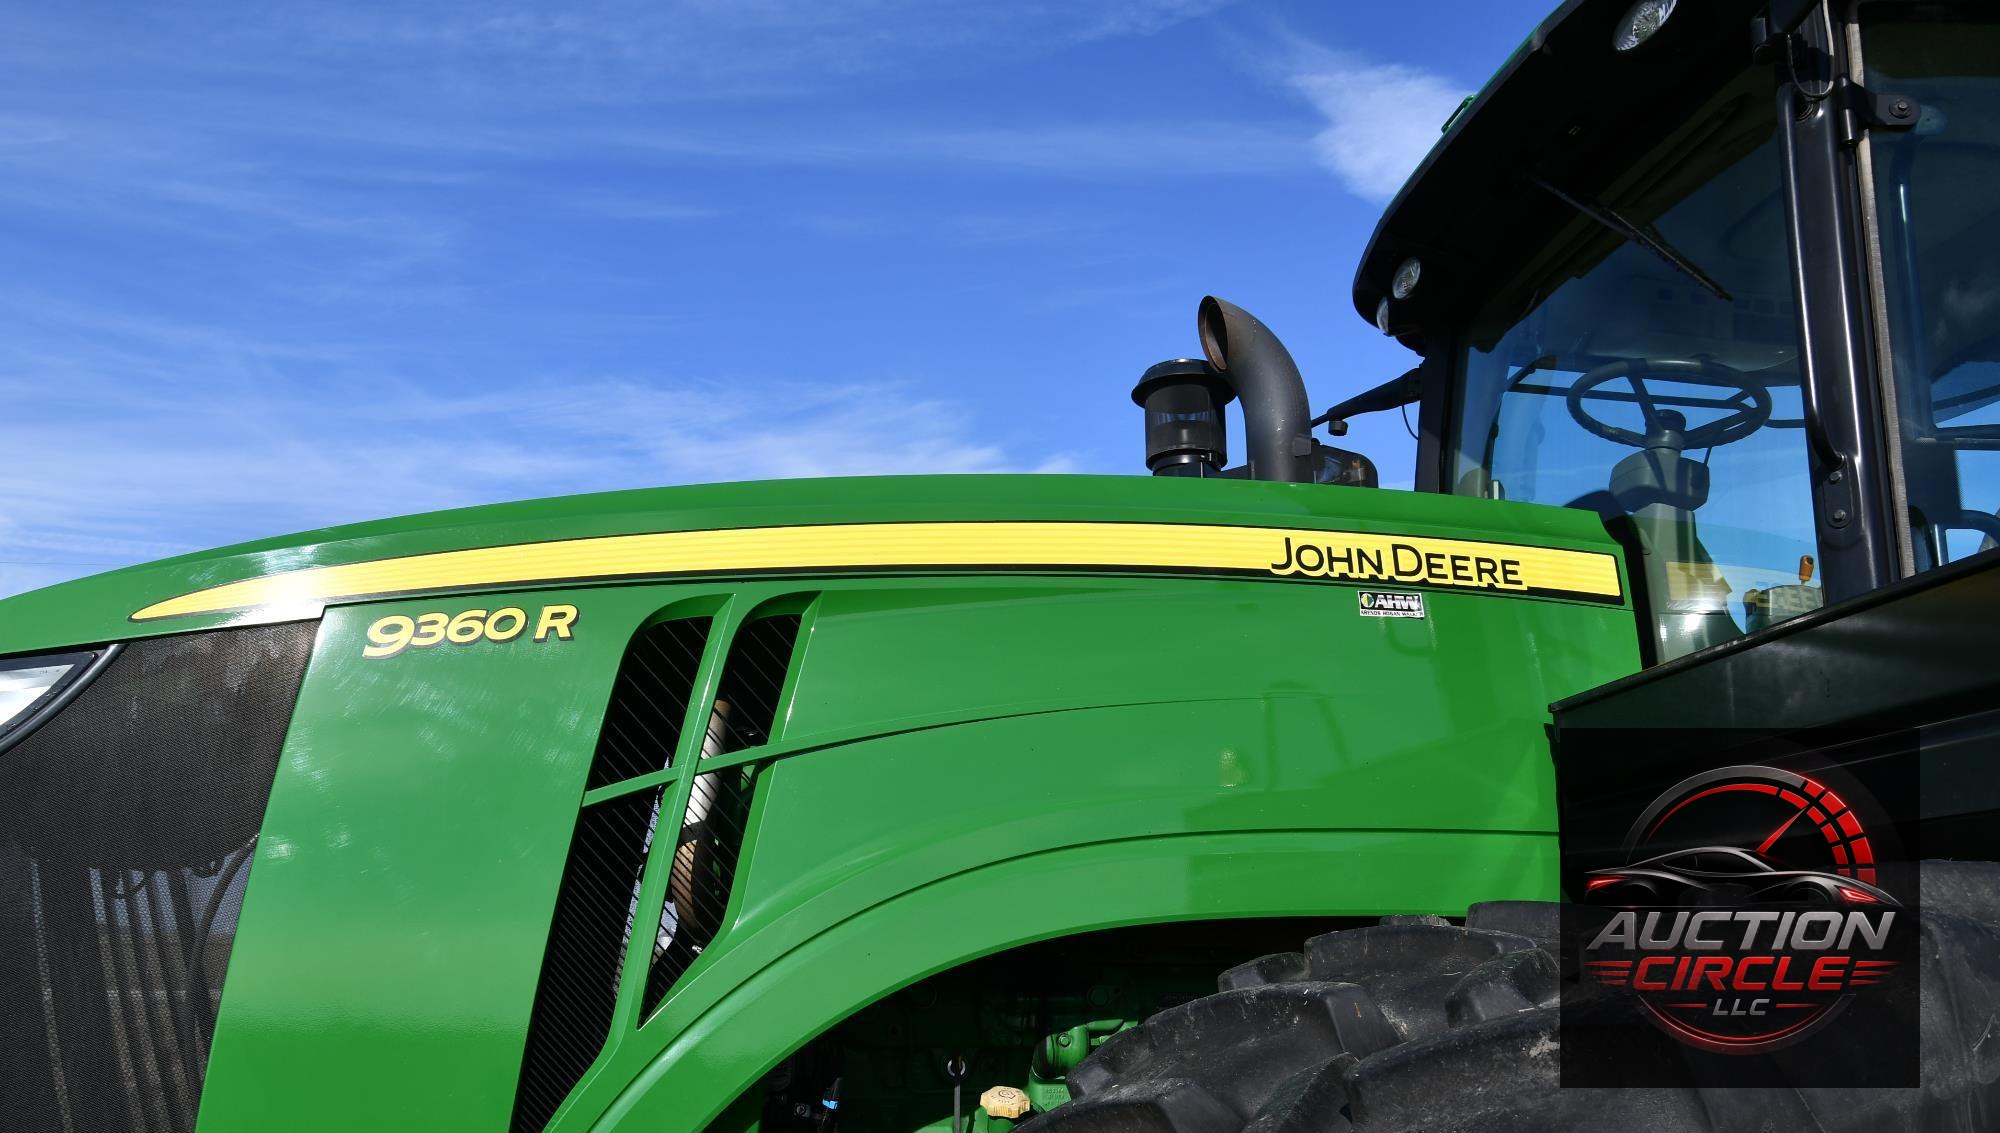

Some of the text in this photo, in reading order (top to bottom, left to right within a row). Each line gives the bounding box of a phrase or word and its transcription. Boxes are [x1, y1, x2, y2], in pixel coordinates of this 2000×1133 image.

[1271, 537, 1523, 585] JOHN DEERE
[1375, 595, 1420, 610] AHW
[362, 604, 579, 660] 9360 R
